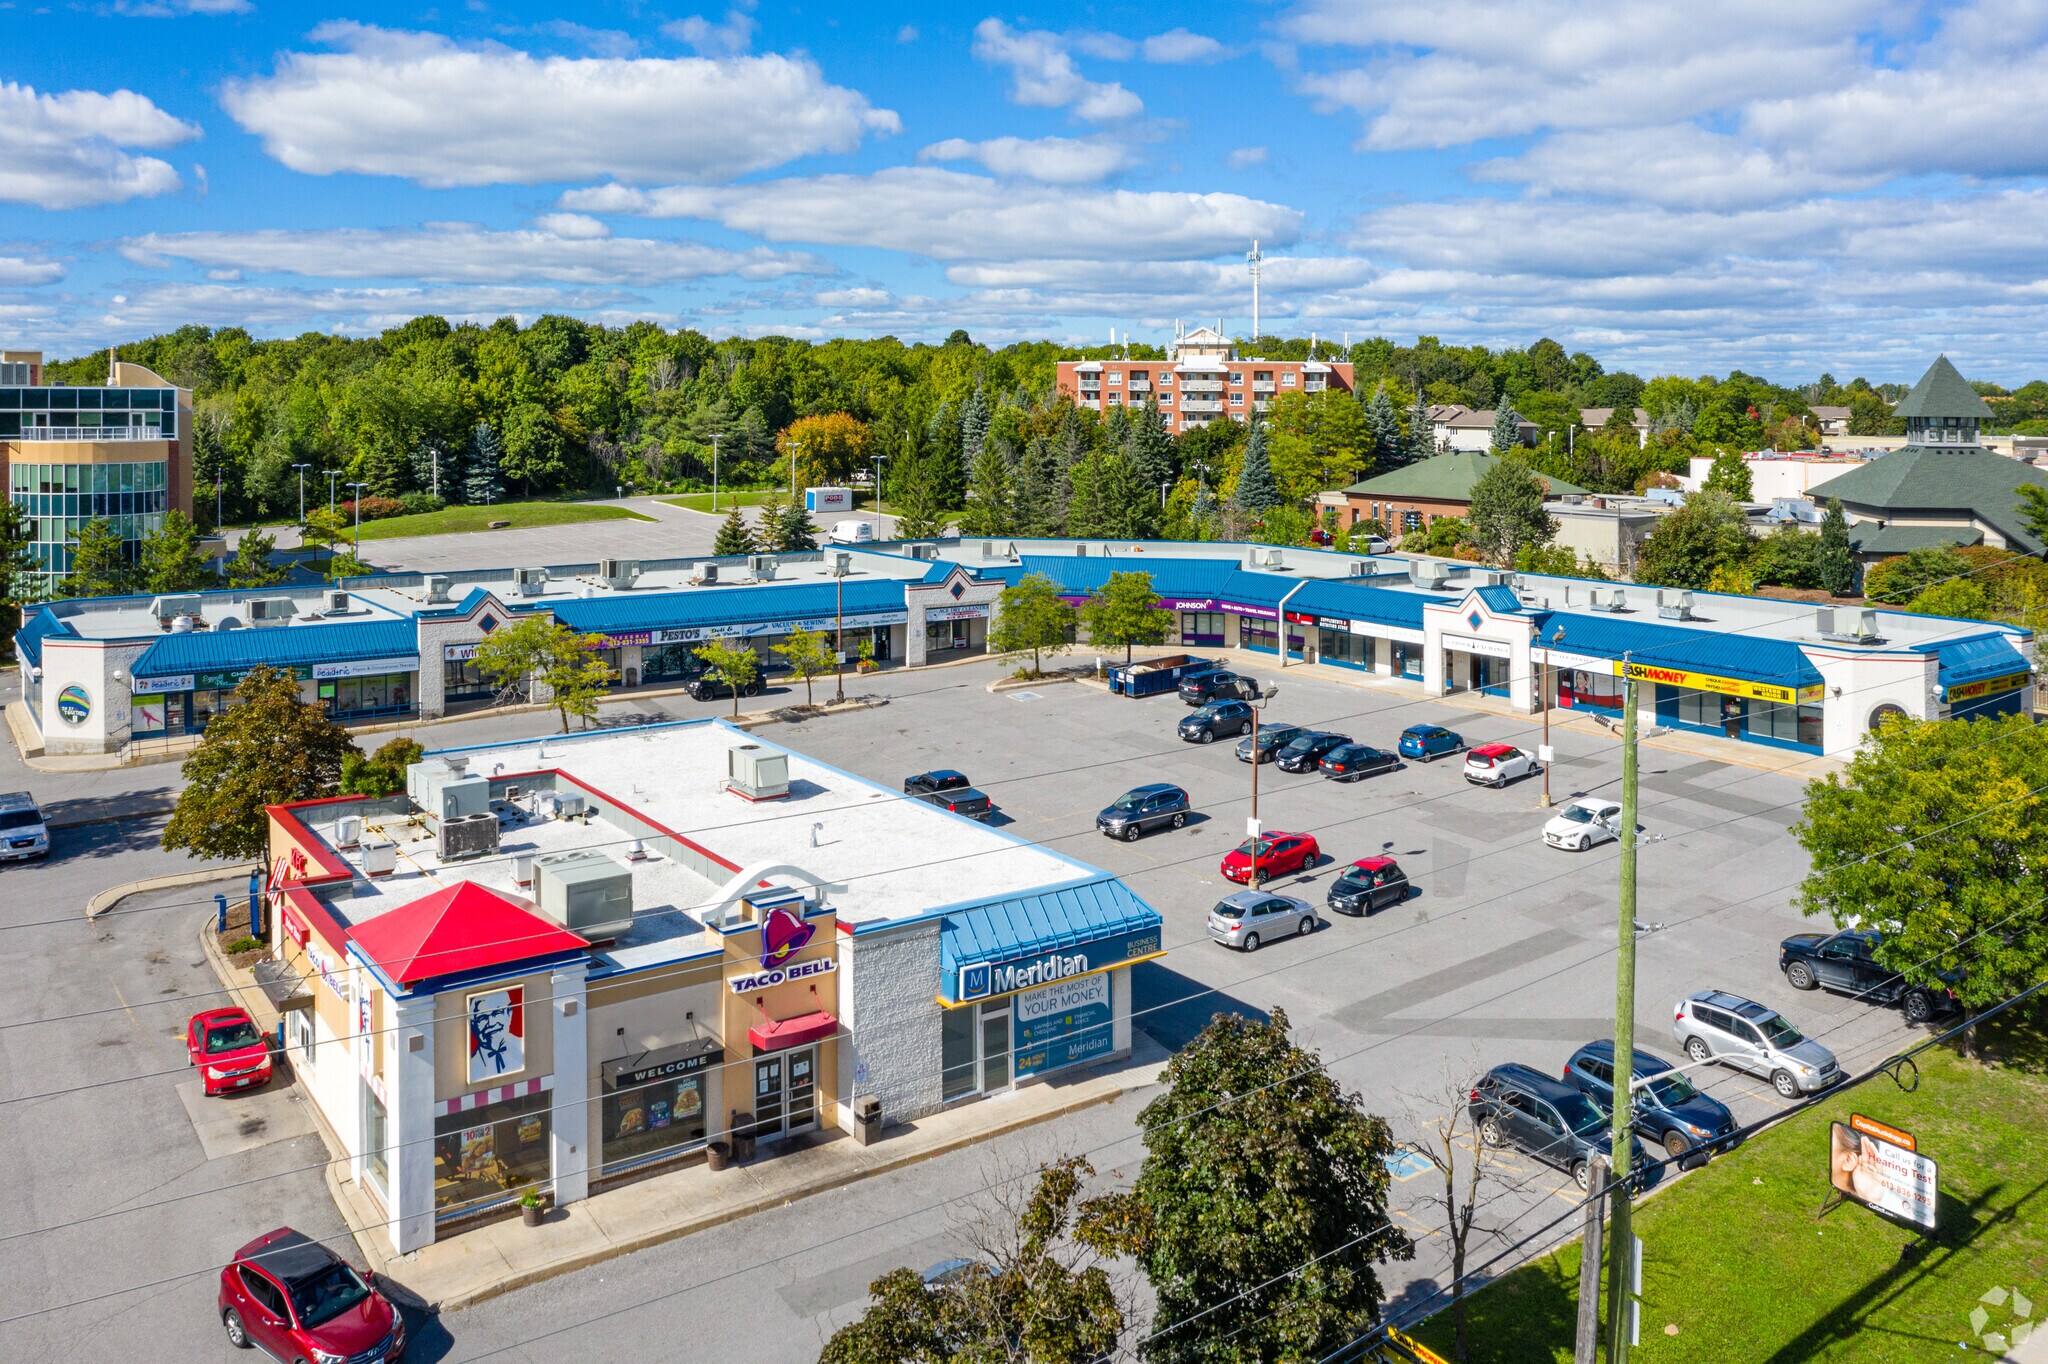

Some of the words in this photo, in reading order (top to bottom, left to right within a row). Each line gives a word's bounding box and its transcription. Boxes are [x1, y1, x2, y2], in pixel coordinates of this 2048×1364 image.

[1257, 609, 1276, 617] INSURANCE
[660, 629, 701, 641] PESTO'S
[317, 665, 350, 677] Pediatric
[151, 679, 180, 688] Pediatric
[1753, 686, 1781, 695] WESTERN
[1761, 691, 1781, 699] UNION
[1127, 936, 1158, 949] BUSINESS
[1127, 943, 1158, 958] CENTRE
[733, 972, 784, 991] TACO
[788, 960, 834, 979] BELL
[994, 954, 1088, 993] Meridian
[329, 974, 344, 999] BELL
[1024, 989, 1047, 1002] MAKE
[1049, 986, 1064, 995] THE
[1067, 980, 1088, 992] MOST
[1091, 976, 1102, 985] OF
[1025, 998, 1057, 1016] YOUR
[1061, 986, 1104, 1008] MONEY.
[1074, 1010, 1096, 1018] FINANCIAL
[1034, 1021, 1053, 1030] SAVINGS
[1074, 1017, 1089, 1025] ADVICE
[1033, 1026, 1057, 1036] CHEQUING
[1068, 1038, 1108, 1056] Meridian
[635, 1056, 708, 1081] WELCOME
[1018, 1057, 1031, 1070] 24
[484, 1126, 491, 1136] 2
[1884, 1148, 1900, 1161] Call
[1902, 1156, 1911, 1165] us
[1914, 1159, 1925, 1171] for
[1868, 1152, 1908, 1177] Hearing
[1911, 1169, 1932, 1185] Test
[1880, 1180, 1932, 1206] 613-836-1295
